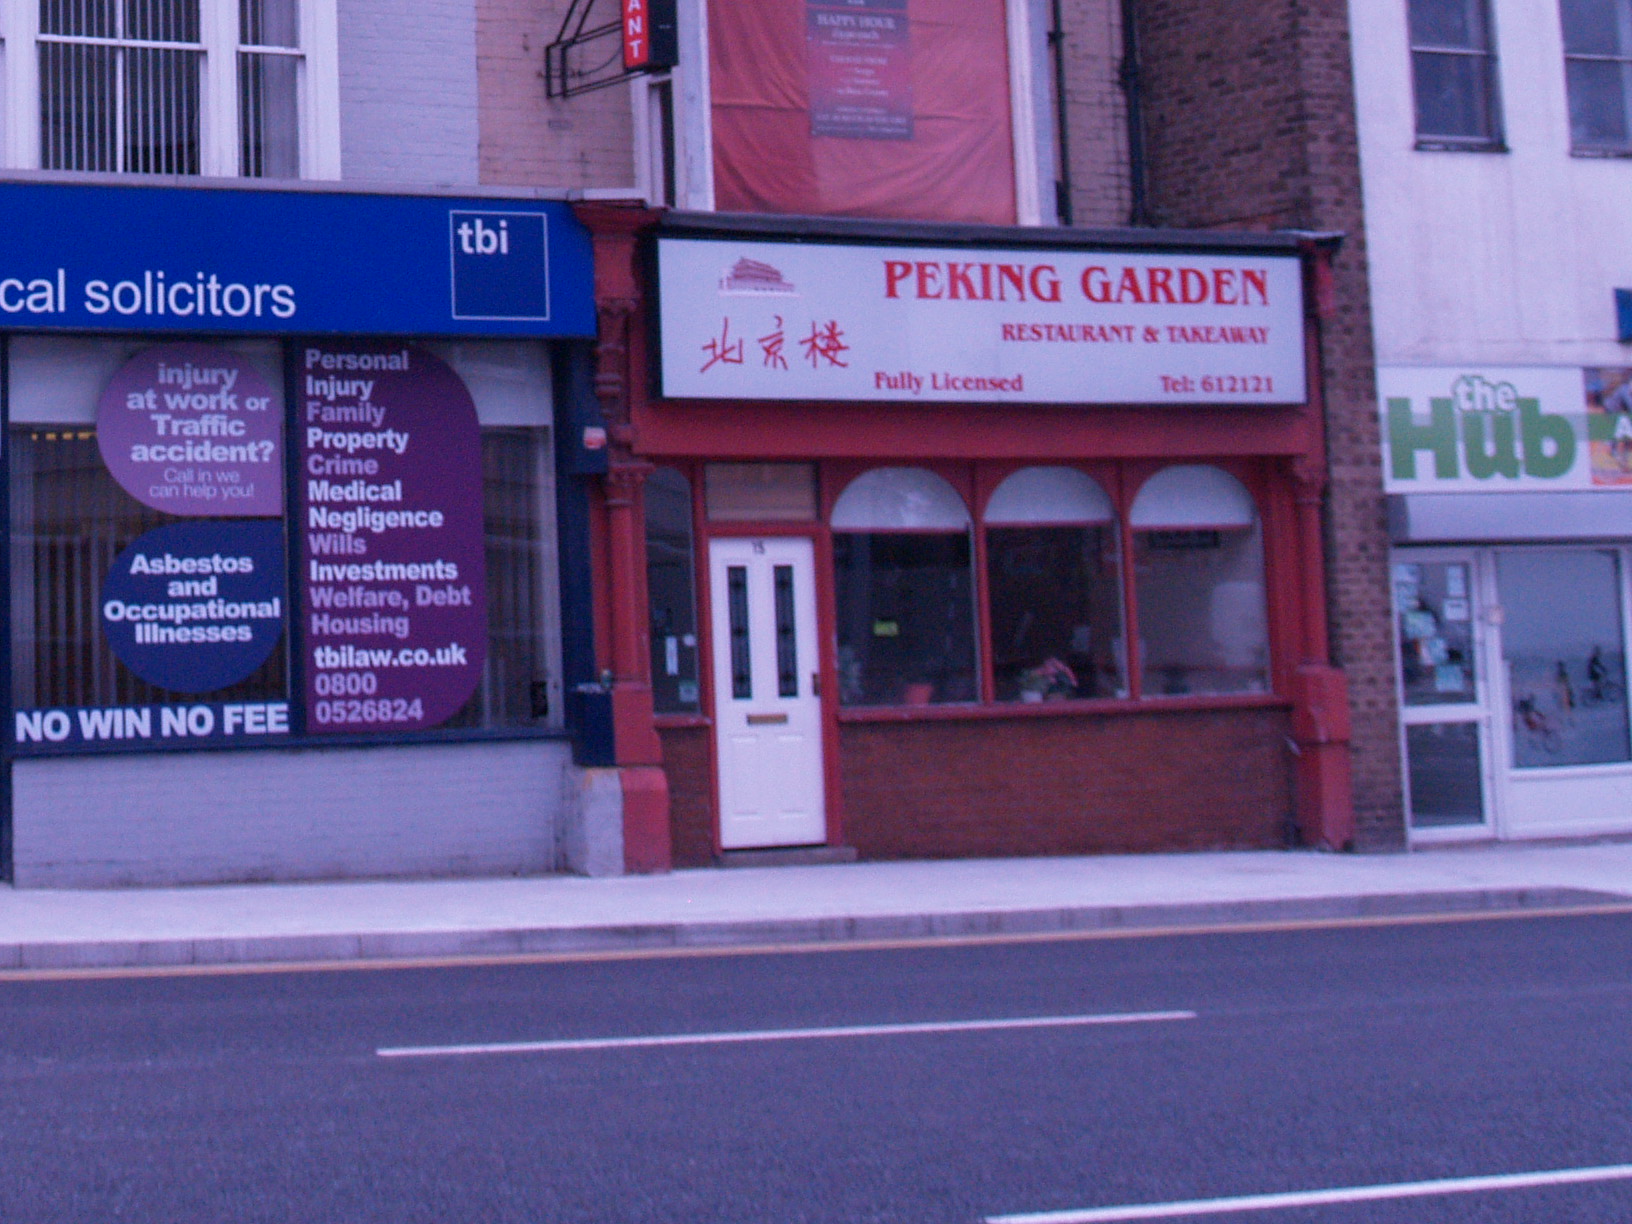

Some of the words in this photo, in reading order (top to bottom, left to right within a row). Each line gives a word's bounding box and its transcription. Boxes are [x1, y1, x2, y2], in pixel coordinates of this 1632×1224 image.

[456, 220, 509, 255] tbi
[83, 271, 297, 318] solicitors
[883, 260, 1062, 303] PEKING
[1080, 266, 1270, 306] GARDEN
[1002, 323, 1135, 344] RESTAURANT
[1143, 327, 1159, 344] &
[1166, 326, 1269, 345] TAKEAWAY
[305, 348, 409, 370] Personal
[157, 363, 239, 391] injury
[306, 375, 374, 401] Injury
[874, 371, 925, 395] Fully
[930, 372, 1024, 393] Licensed
[1160, 375, 1196, 393] Tel:
[1201, 376, 1274, 394] 612121
[126, 389, 157, 410] at
[164, 387, 238, 410] work
[245, 396, 270, 411] or
[1454, 376, 1517, 412] the
[150, 413, 246, 436] Traffic
[306, 401, 386, 427] Family
[130, 439, 275, 463] accident?
[306, 427, 409, 453] Property
[1386, 397, 1576, 481] Hub
[164, 467, 195, 483] Call
[198, 468, 212, 483] in
[217, 471, 240, 483] we
[307, 453, 379, 475] Crime
[149, 485, 179, 498] can
[183, 482, 217, 500] help
[221, 482, 255, 501] you!
[308, 479, 402, 502] Medical
[308, 506, 444, 533] Negligence
[308, 532, 367, 555] Wills
[129, 553, 254, 575] Asbestos
[309, 558, 459, 581] Investments
[167, 576, 218, 597] and
[309, 585, 410, 612] Welfare,
[416, 584, 472, 607] Debt
[103, 597, 281, 625] Occupational
[134, 622, 253, 644] Illnesses
[311, 612, 410, 639] Housing
[313, 642, 468, 669] tbilaw.co.uk
[314, 671, 378, 696] 0800
[15, 710, 70, 743] NO
[77, 707, 152, 740] WIN
[160, 705, 215, 738] NO
[222, 703, 290, 735] FEE
[315, 698, 424, 724] 0526824
